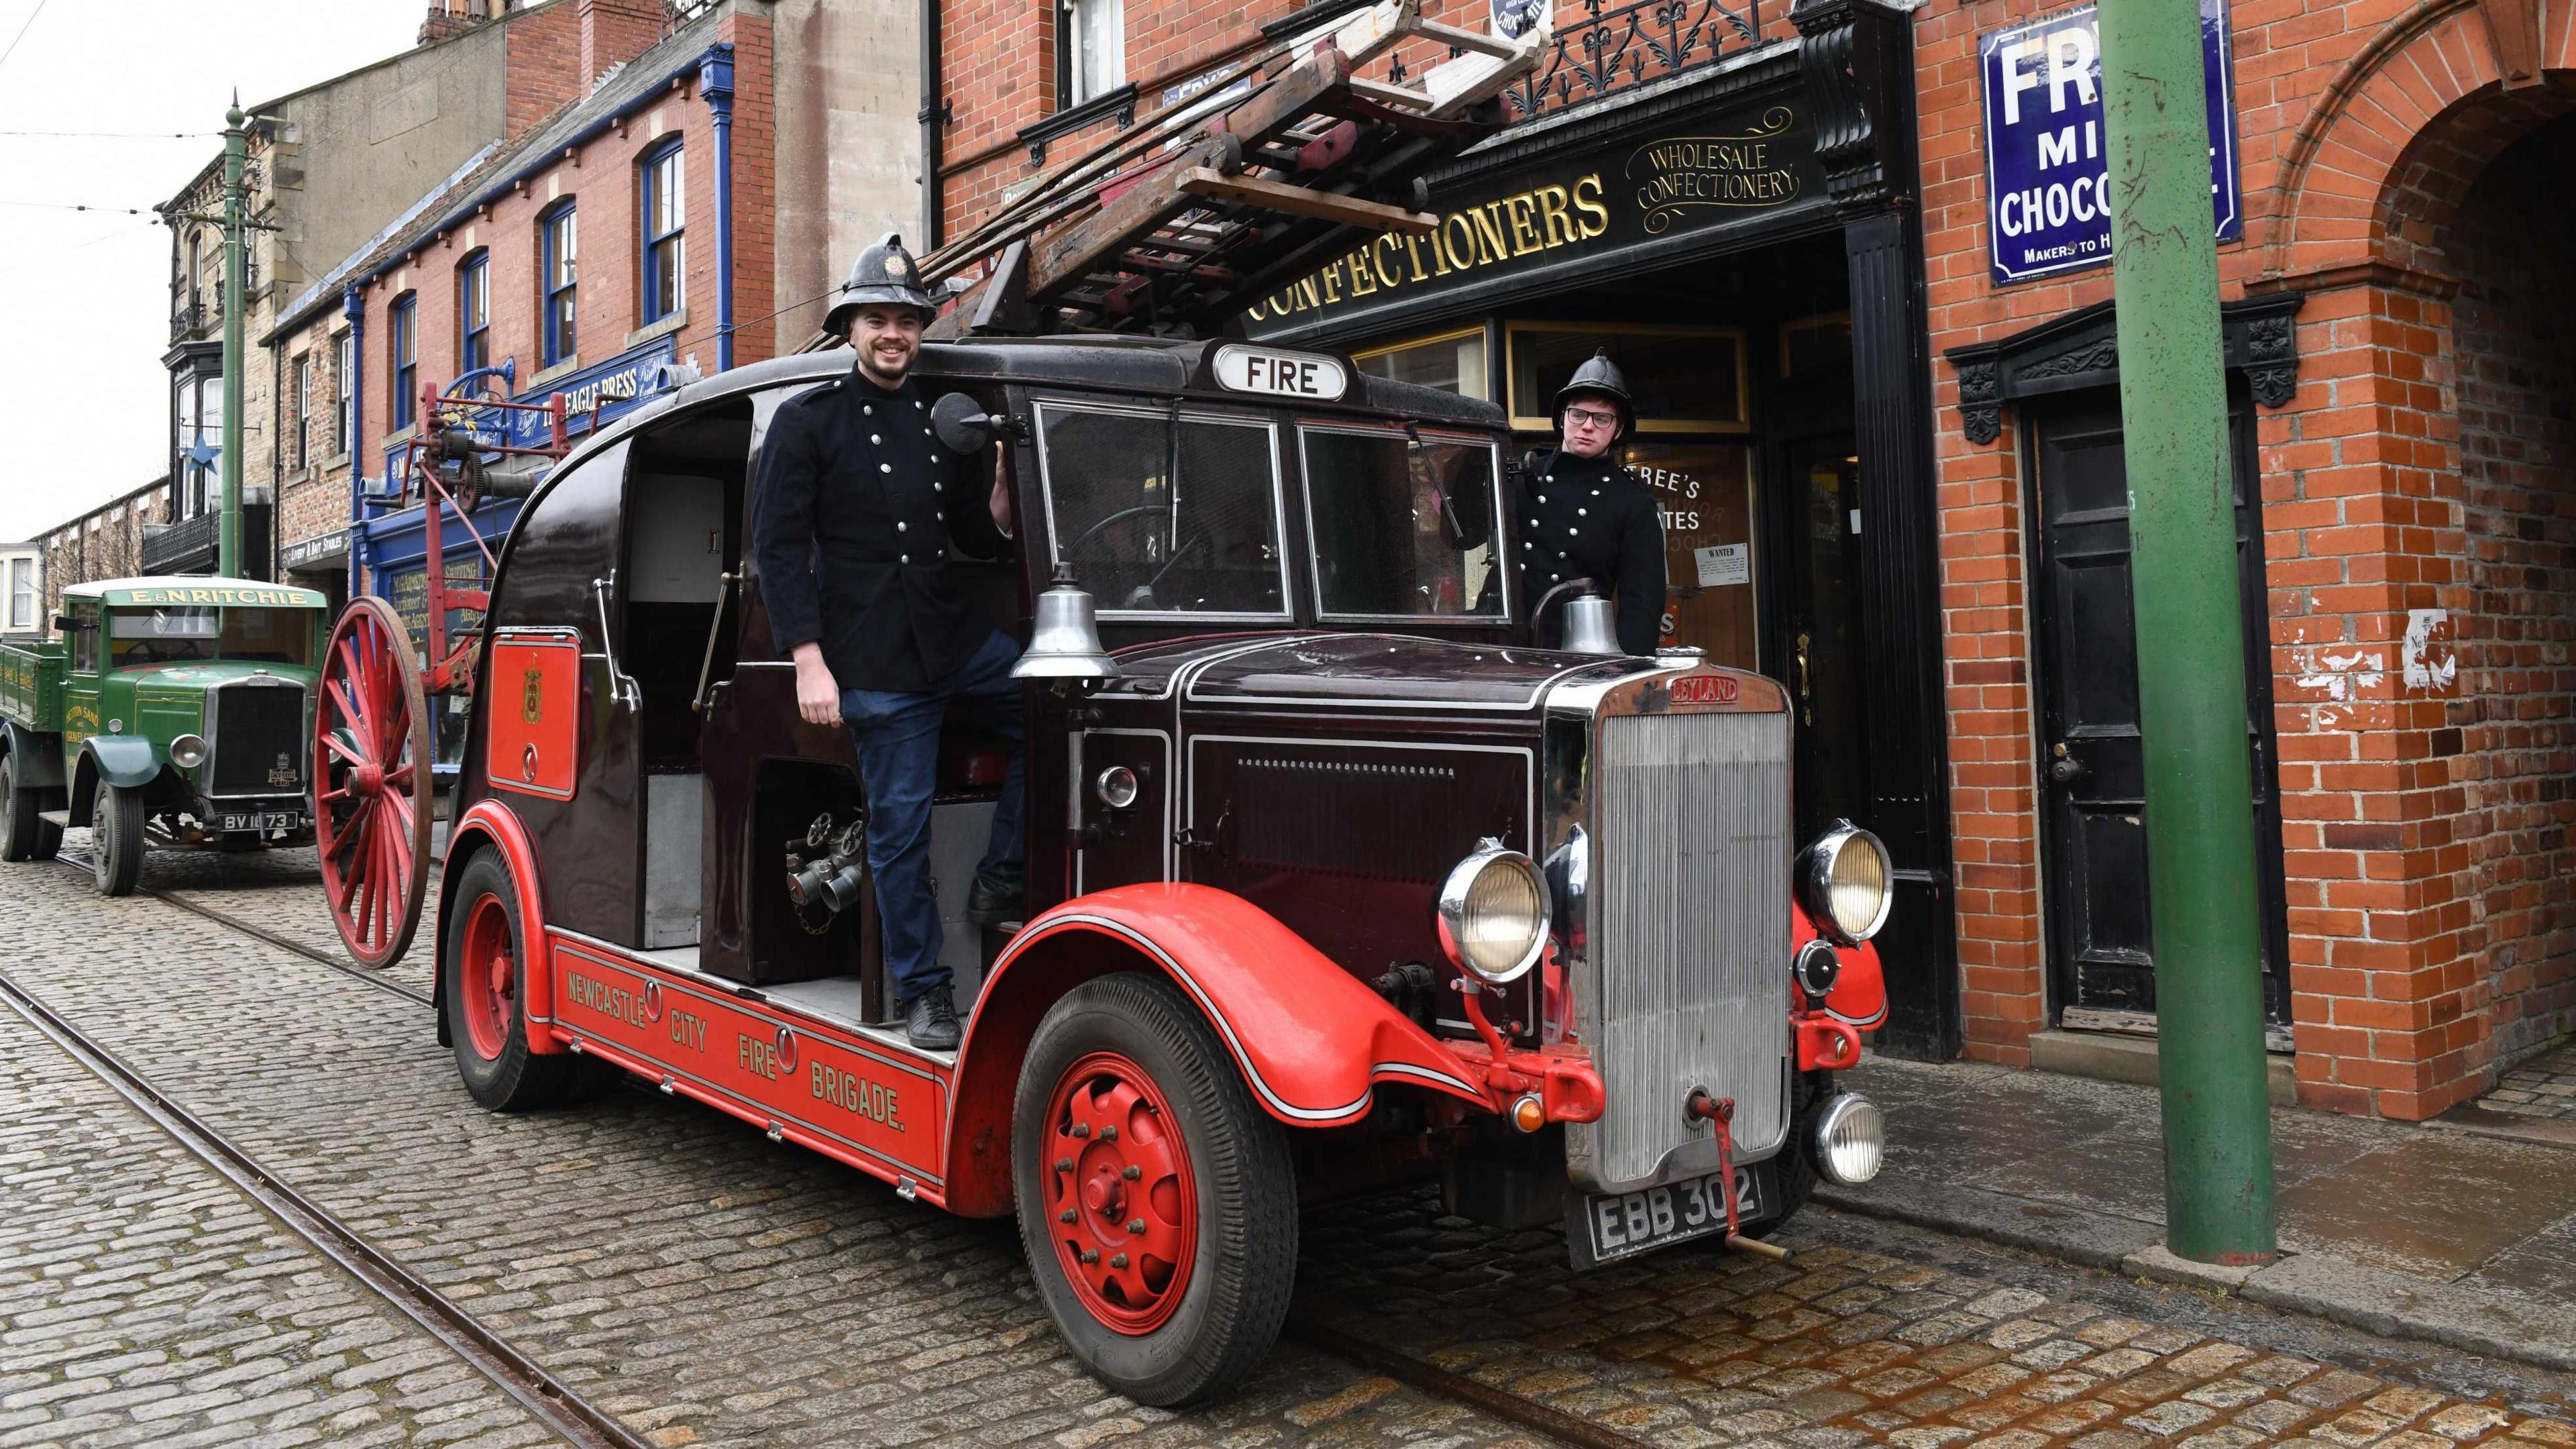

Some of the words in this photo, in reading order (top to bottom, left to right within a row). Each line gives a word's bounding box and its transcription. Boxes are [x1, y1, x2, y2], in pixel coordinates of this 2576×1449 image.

[1497, 0, 1544, 30] CHOCOATE
[1649, 144, 1768, 170] WHOLESALE
[2037, 120, 2098, 170] MI
[1638, 163, 1792, 209] CONFECTIONERY
[2079, 241, 2096, 253] TO
[1248, 356, 1318, 394] FIRE
[565, 382, 598, 417] EAGLE
[601, 368, 637, 407] PRESS
[323, 536, 341, 552] STABLES
[1708, 547, 1734, 558] WANTED
[1671, 678, 1737, 701] LEYLAND
[83, 706, 99, 727] SAND
[225, 816, 246, 829] BV
[568, 971, 646, 1029] NEWCASTLE
[671, 1008, 707, 1053] CITY
[739, 1033, 777, 1081] FIRE
[810, 1059, 905, 1132] BRIGADE.
[1597, 1187, 1675, 1250] EBB
[1680, 1167, 1755, 1226] 302
